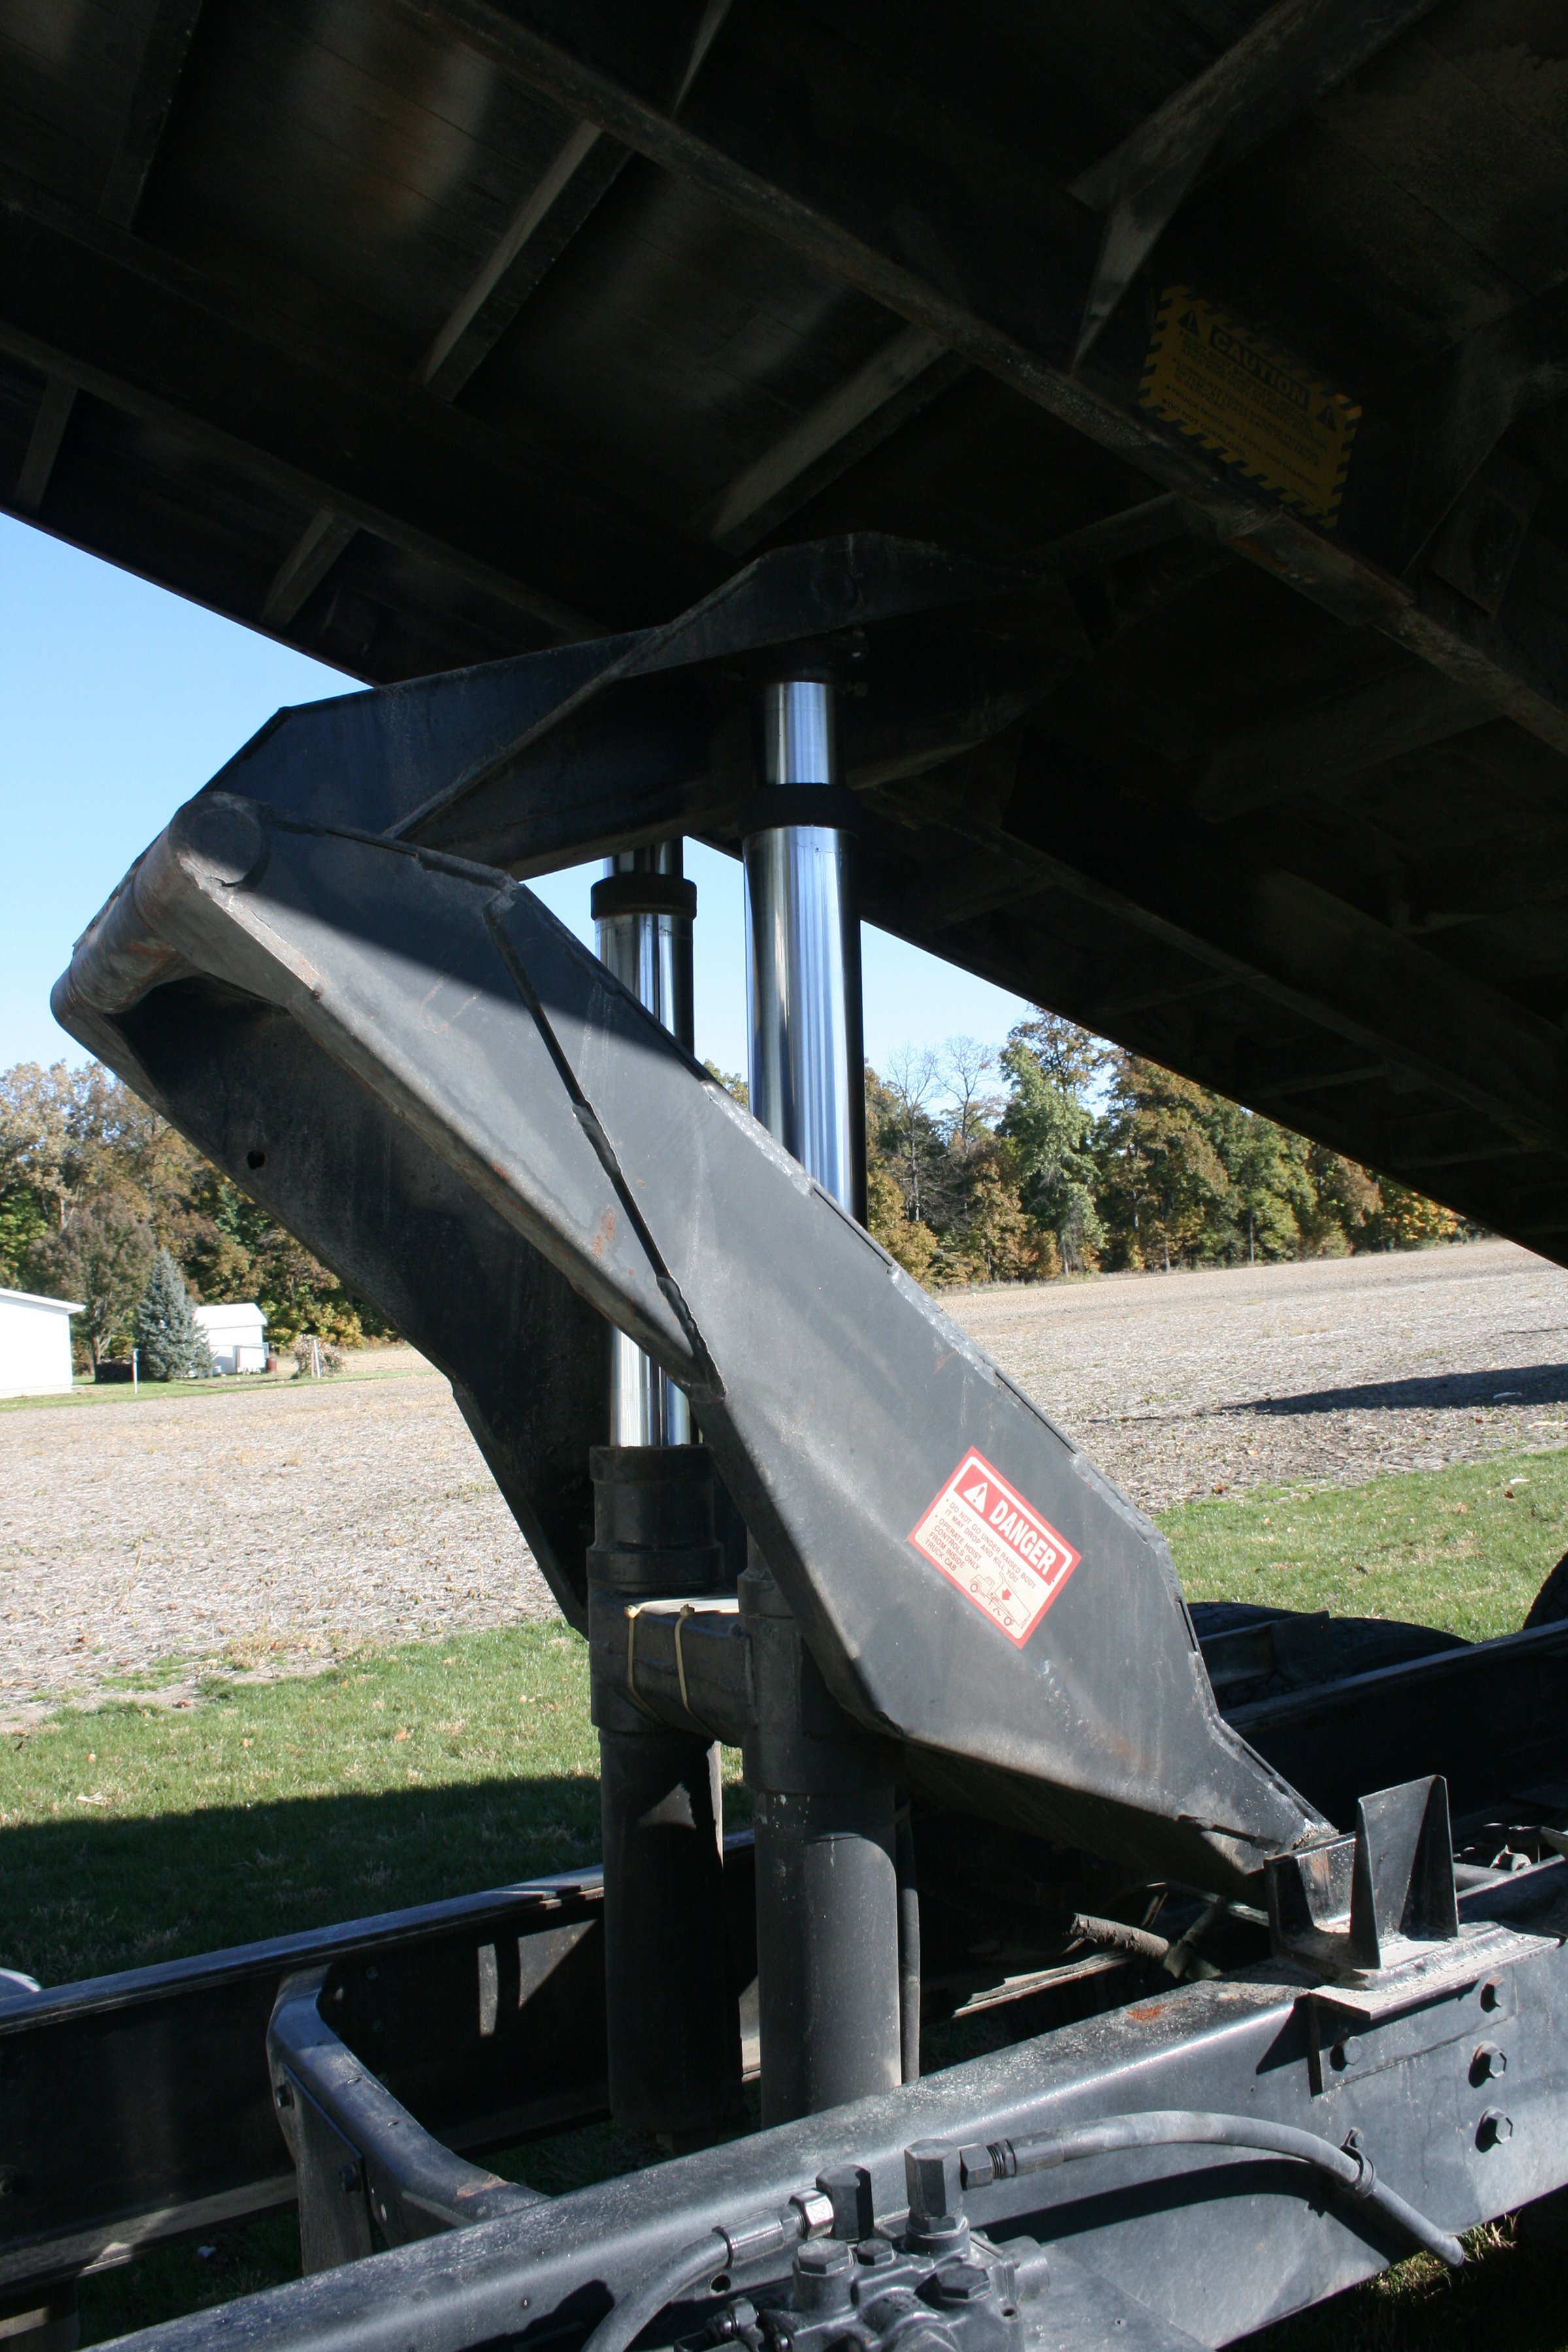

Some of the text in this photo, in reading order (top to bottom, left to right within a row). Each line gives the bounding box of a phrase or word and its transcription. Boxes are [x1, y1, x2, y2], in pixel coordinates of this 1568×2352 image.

[1212, 329, 1307, 407] CAUTION
[1168, 400, 1245, 458] DO NOT OVERLOAD
[1171, 386, 1198, 410] TRUCK
[1200, 406, 1223, 427] MUST
[1238, 431, 1262, 453] LEVEL
[1264, 449, 1281, 466] FOR
[924, 1538, 956, 1571] TRUCK CAB
[929, 1531, 965, 1568] FROM INSIDE
[934, 1525, 980, 1571] CONTROLS ONLY
[938, 1518, 981, 1561] OPERATE HOIST
[945, 1508, 1018, 1582] IT MAY DROP AND KILL YOU
[949, 1501, 1036, 1589] DO NOT GO UNDER RAISED BODY
[988, 1499, 1056, 1575] DANGER
